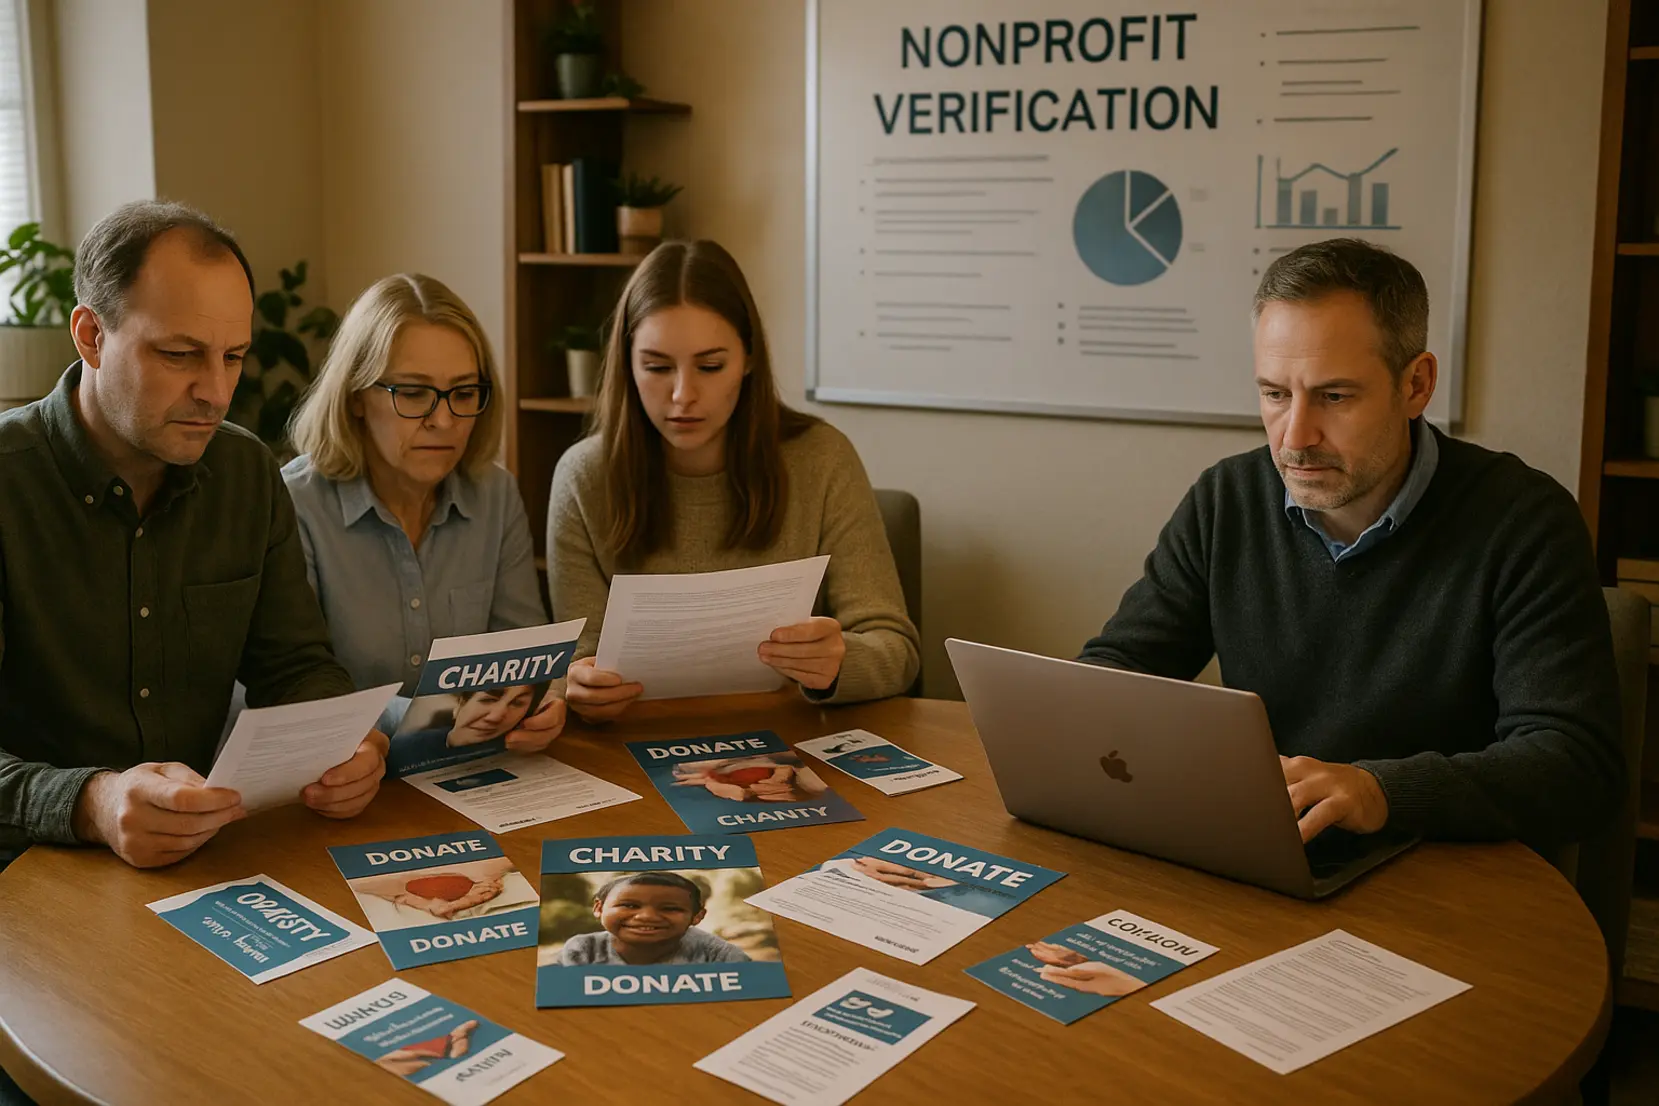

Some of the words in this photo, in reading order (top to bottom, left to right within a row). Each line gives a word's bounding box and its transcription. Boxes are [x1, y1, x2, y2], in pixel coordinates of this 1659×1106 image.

[902, 13, 1198, 68] NONPROFIT
[874, 85, 1219, 135] VERIFICATION
[438, 651, 565, 690] CHARITY
[646, 738, 768, 760] DONATE
[365, 839, 487, 866] DONATE
[569, 845, 730, 864] CHARITY
[879, 838, 1034, 888] DONATE
[409, 922, 529, 954] DONATE
[584, 972, 742, 995] DONATE
